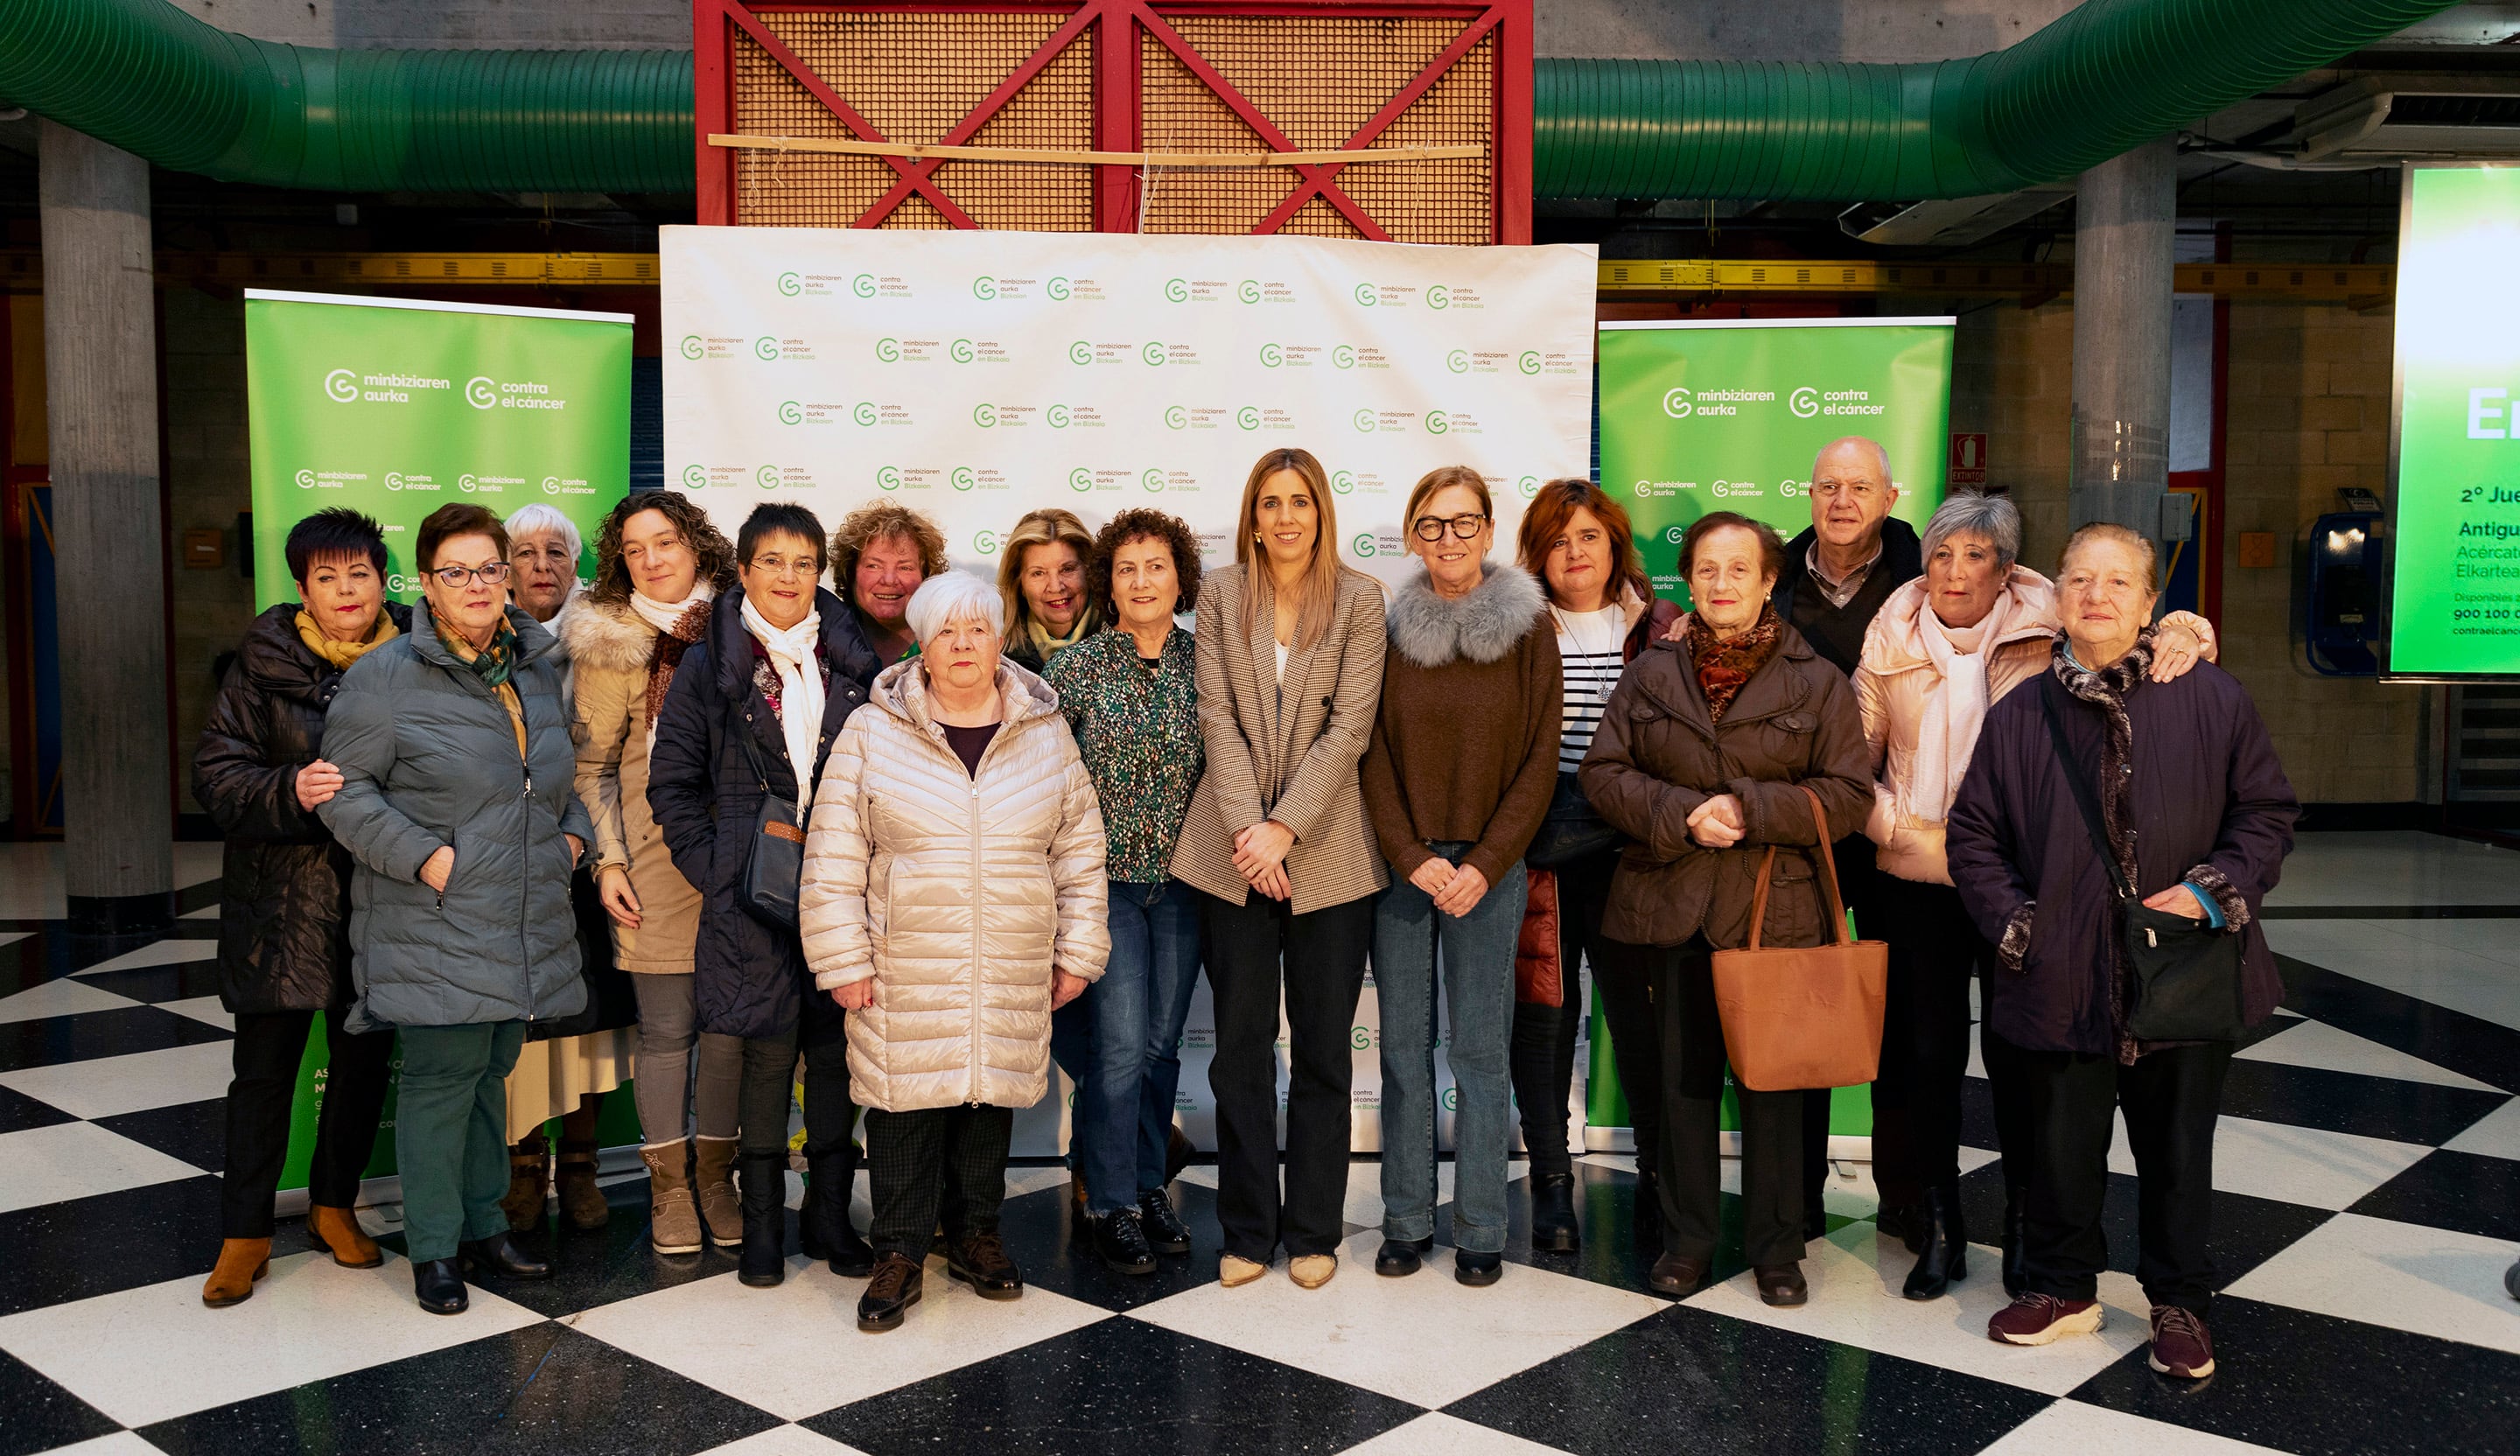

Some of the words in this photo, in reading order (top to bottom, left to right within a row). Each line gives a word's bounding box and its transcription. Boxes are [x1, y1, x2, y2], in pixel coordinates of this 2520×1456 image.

[364, 373, 450, 389] minbiziaren
[501, 382, 549, 395] contra
[364, 389, 409, 403] aurka
[1697, 389, 1775, 402] minbiziaren
[1824, 388, 1868, 402] contra
[501, 396, 515, 409] el
[516, 396, 565, 410] cáncer
[1697, 403, 1737, 416] aurka
[1824, 402, 1836, 415] el
[1838, 402, 1885, 416] cáncer
[318, 471, 367, 480] minbiziaren
[479, 475, 525, 485] minbiziaren
[1952, 471, 1985, 481] EXTINTOR
[318, 480, 343, 488] aurka
[405, 482, 413, 491] el
[414, 482, 441, 491] cáncer
[562, 478, 587, 486] contra
[479, 484, 503, 493] aurka
[562, 486, 569, 494] el
[570, 486, 596, 494] cáncer
[1738, 488, 1764, 497] cáncer
[2454, 592, 2513, 603] Disponibles
[2454, 609, 2481, 620] 900
[2485, 609, 2510, 619] 100
